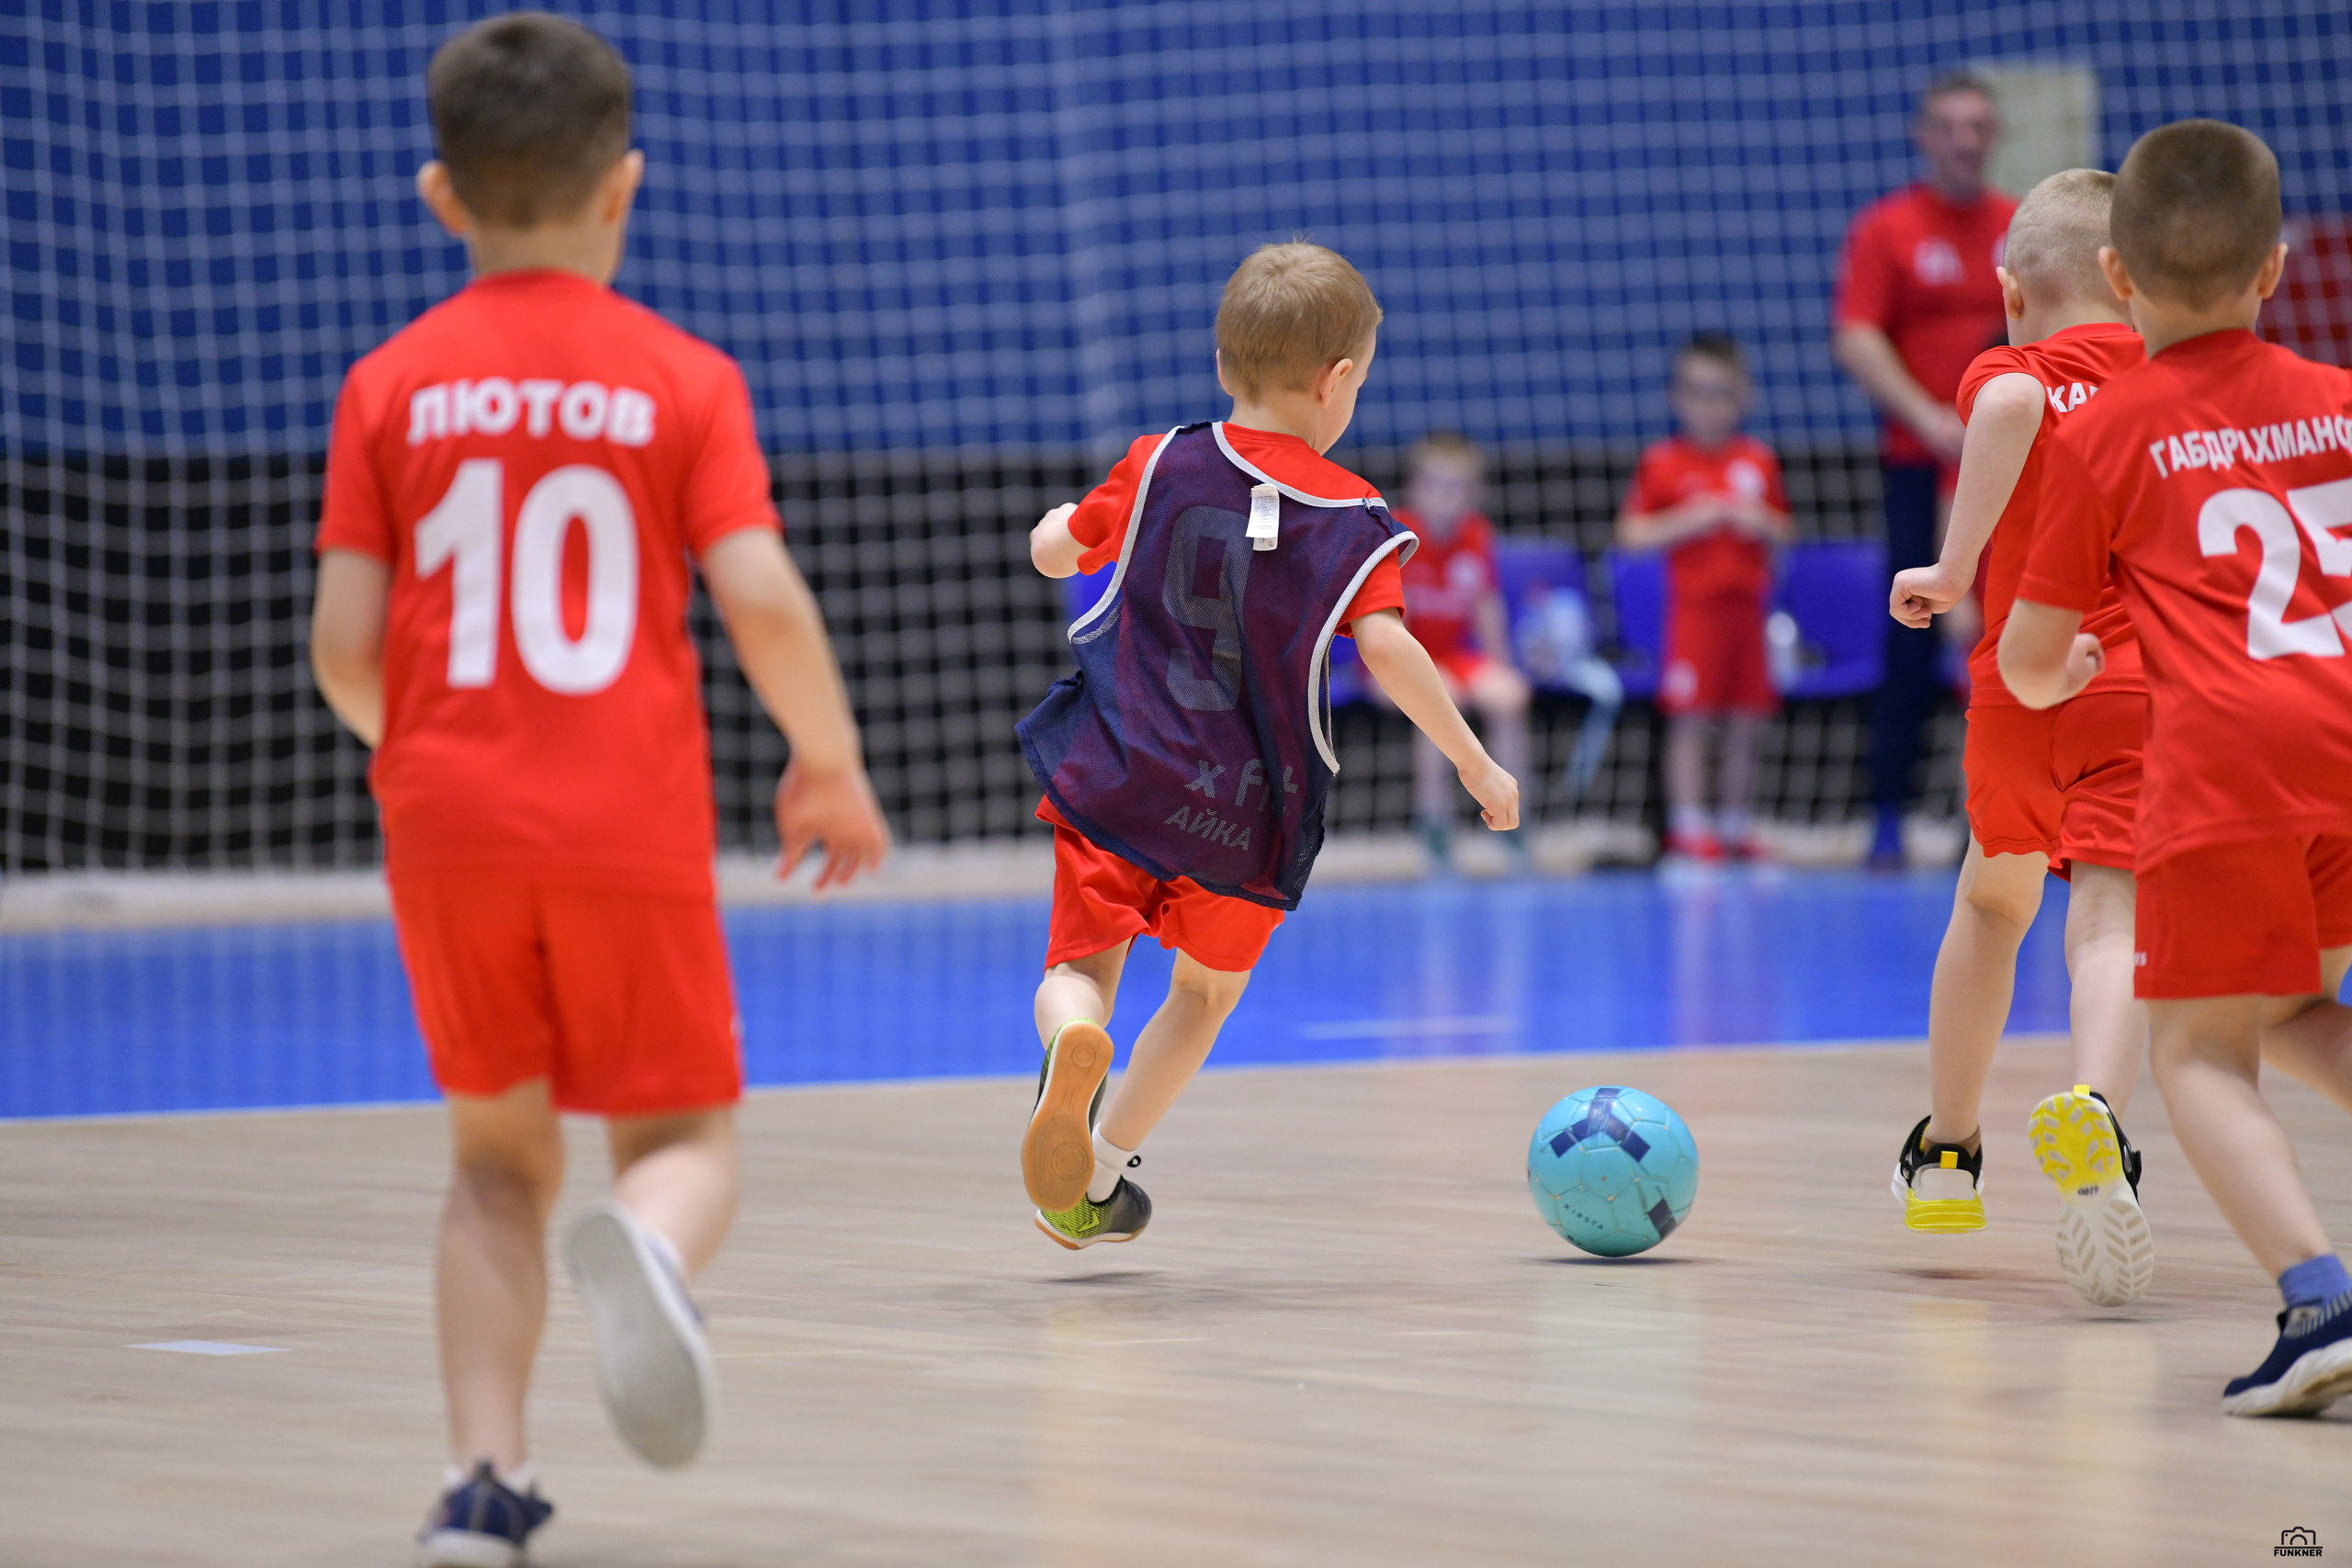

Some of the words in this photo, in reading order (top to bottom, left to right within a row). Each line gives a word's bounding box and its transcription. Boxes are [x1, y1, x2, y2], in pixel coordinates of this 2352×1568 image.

[406, 378, 657, 447] ЛЮТОВ
[2046, 382, 2098, 413] КА
[2148, 414, 2352, 479] ГАБДРАХМАНО
[413, 457, 640, 695] 10
[2198, 478, 2352, 660] 25
[1161, 505, 1253, 711] 9
[1564, 1203, 1604, 1230] KIPSTA
